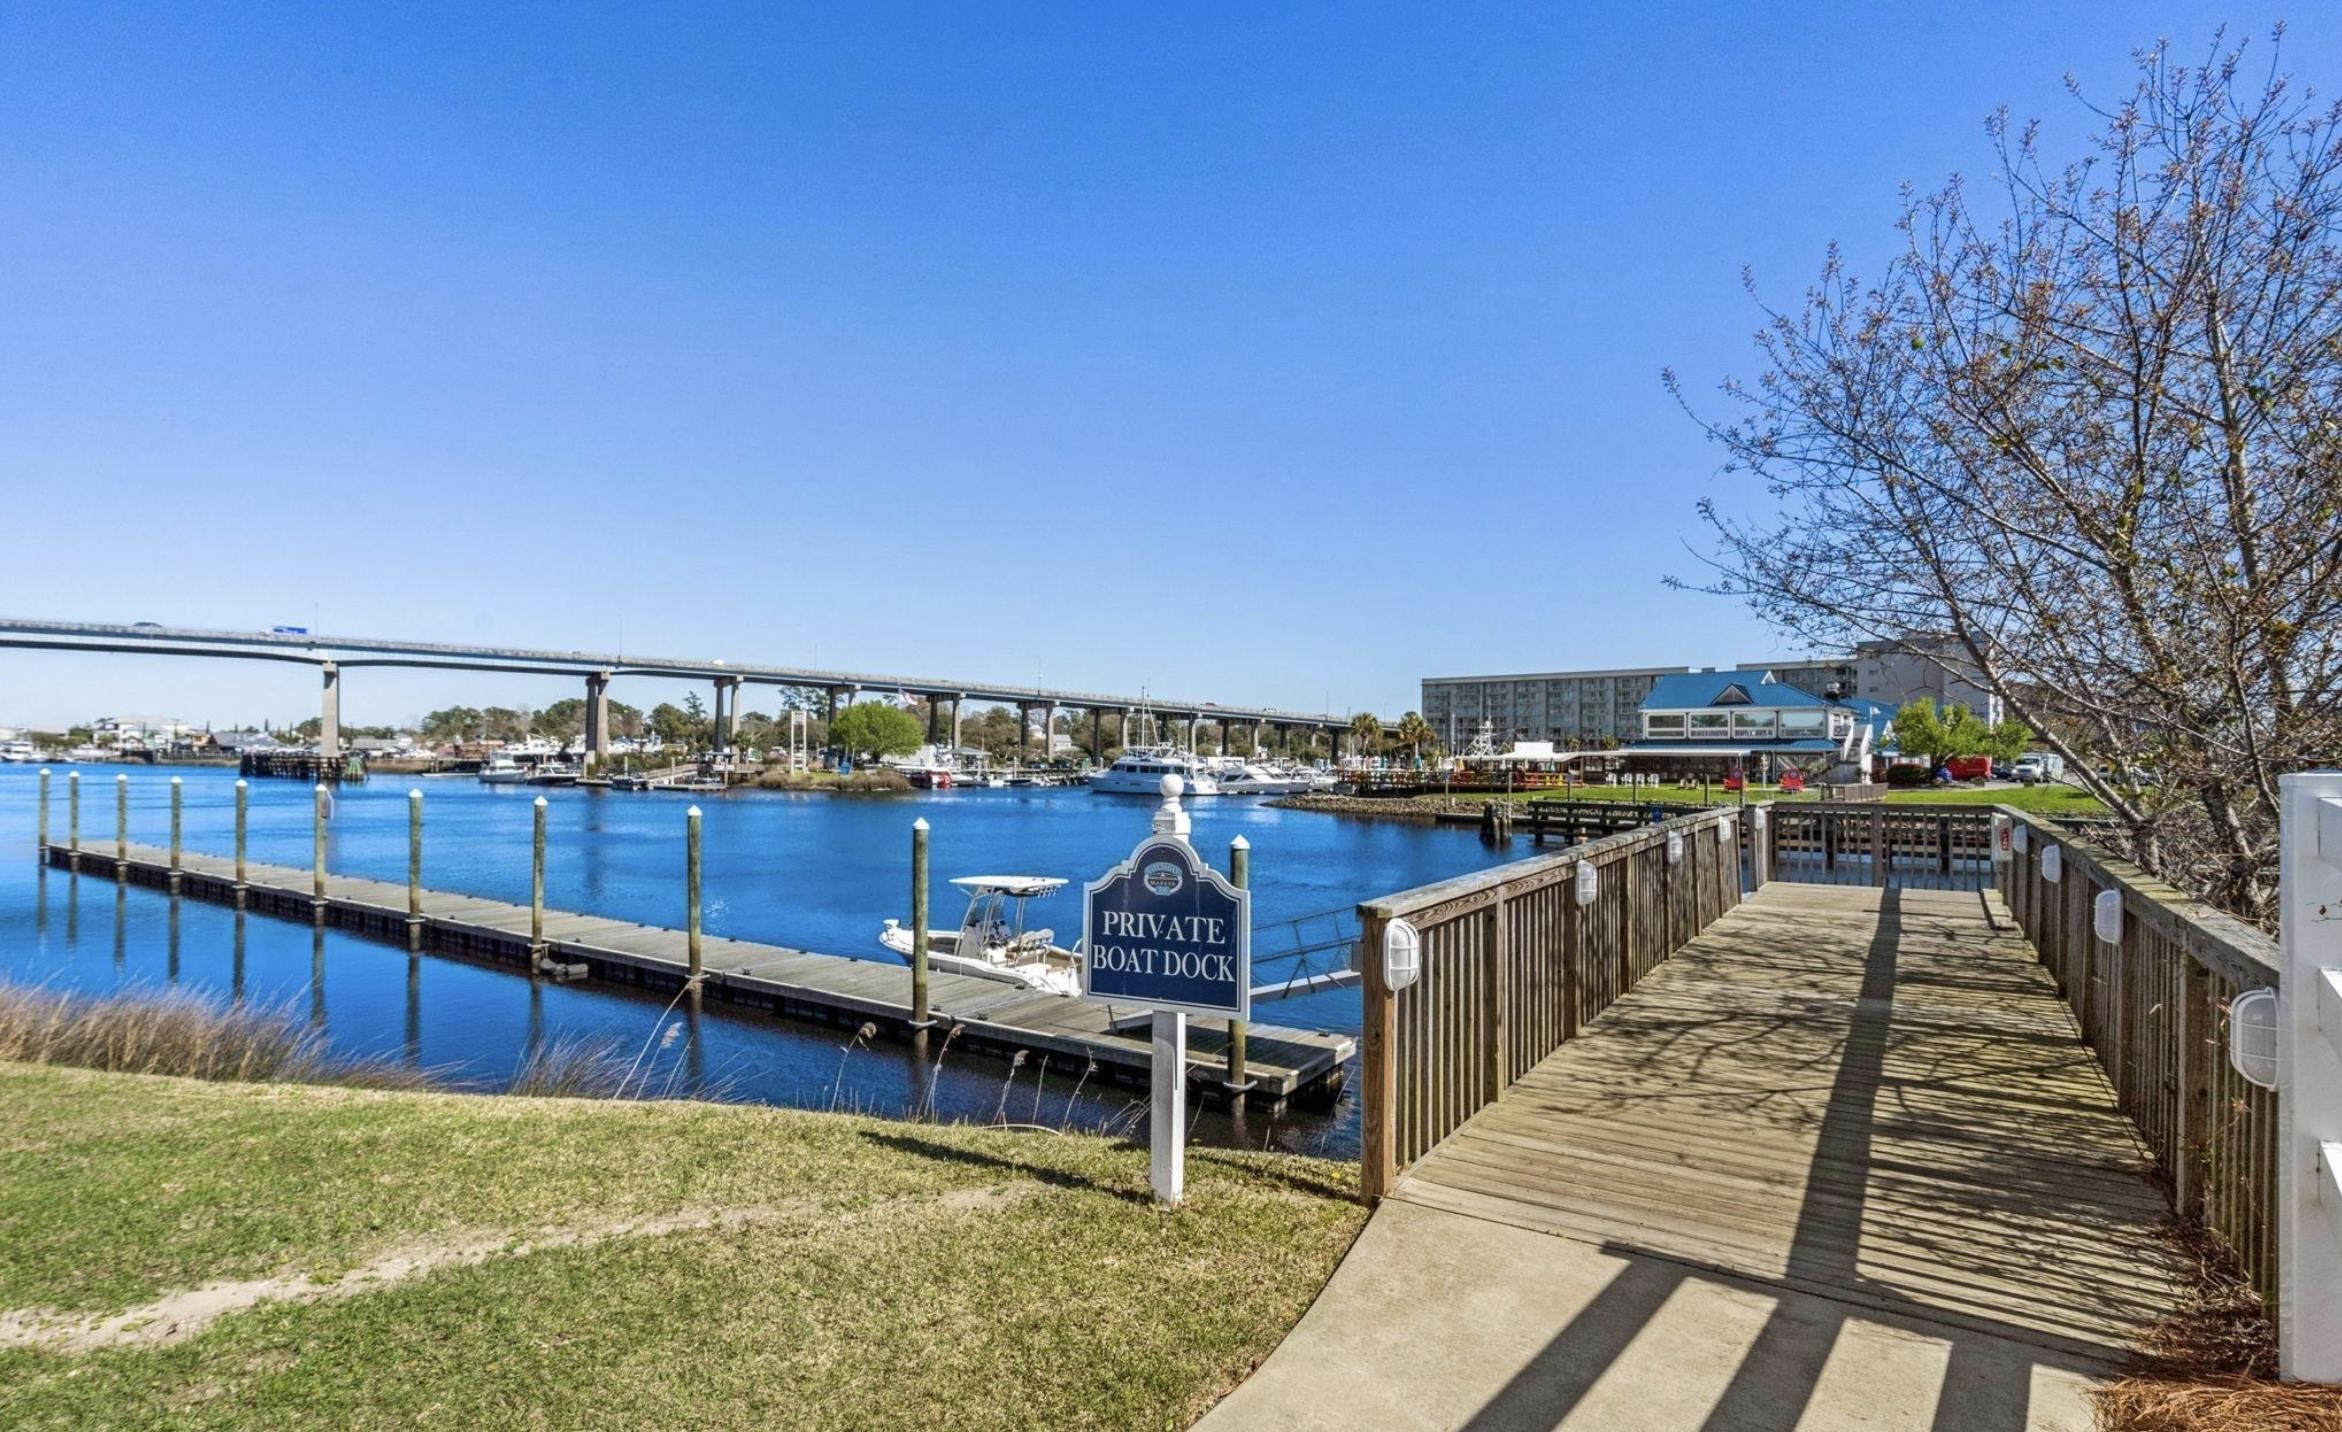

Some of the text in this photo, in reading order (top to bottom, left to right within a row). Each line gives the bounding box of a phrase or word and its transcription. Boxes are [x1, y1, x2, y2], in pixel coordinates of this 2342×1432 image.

[1102, 911, 1225, 944] PRIVATE
[1092, 944, 1236, 982] BOAT DOCK
